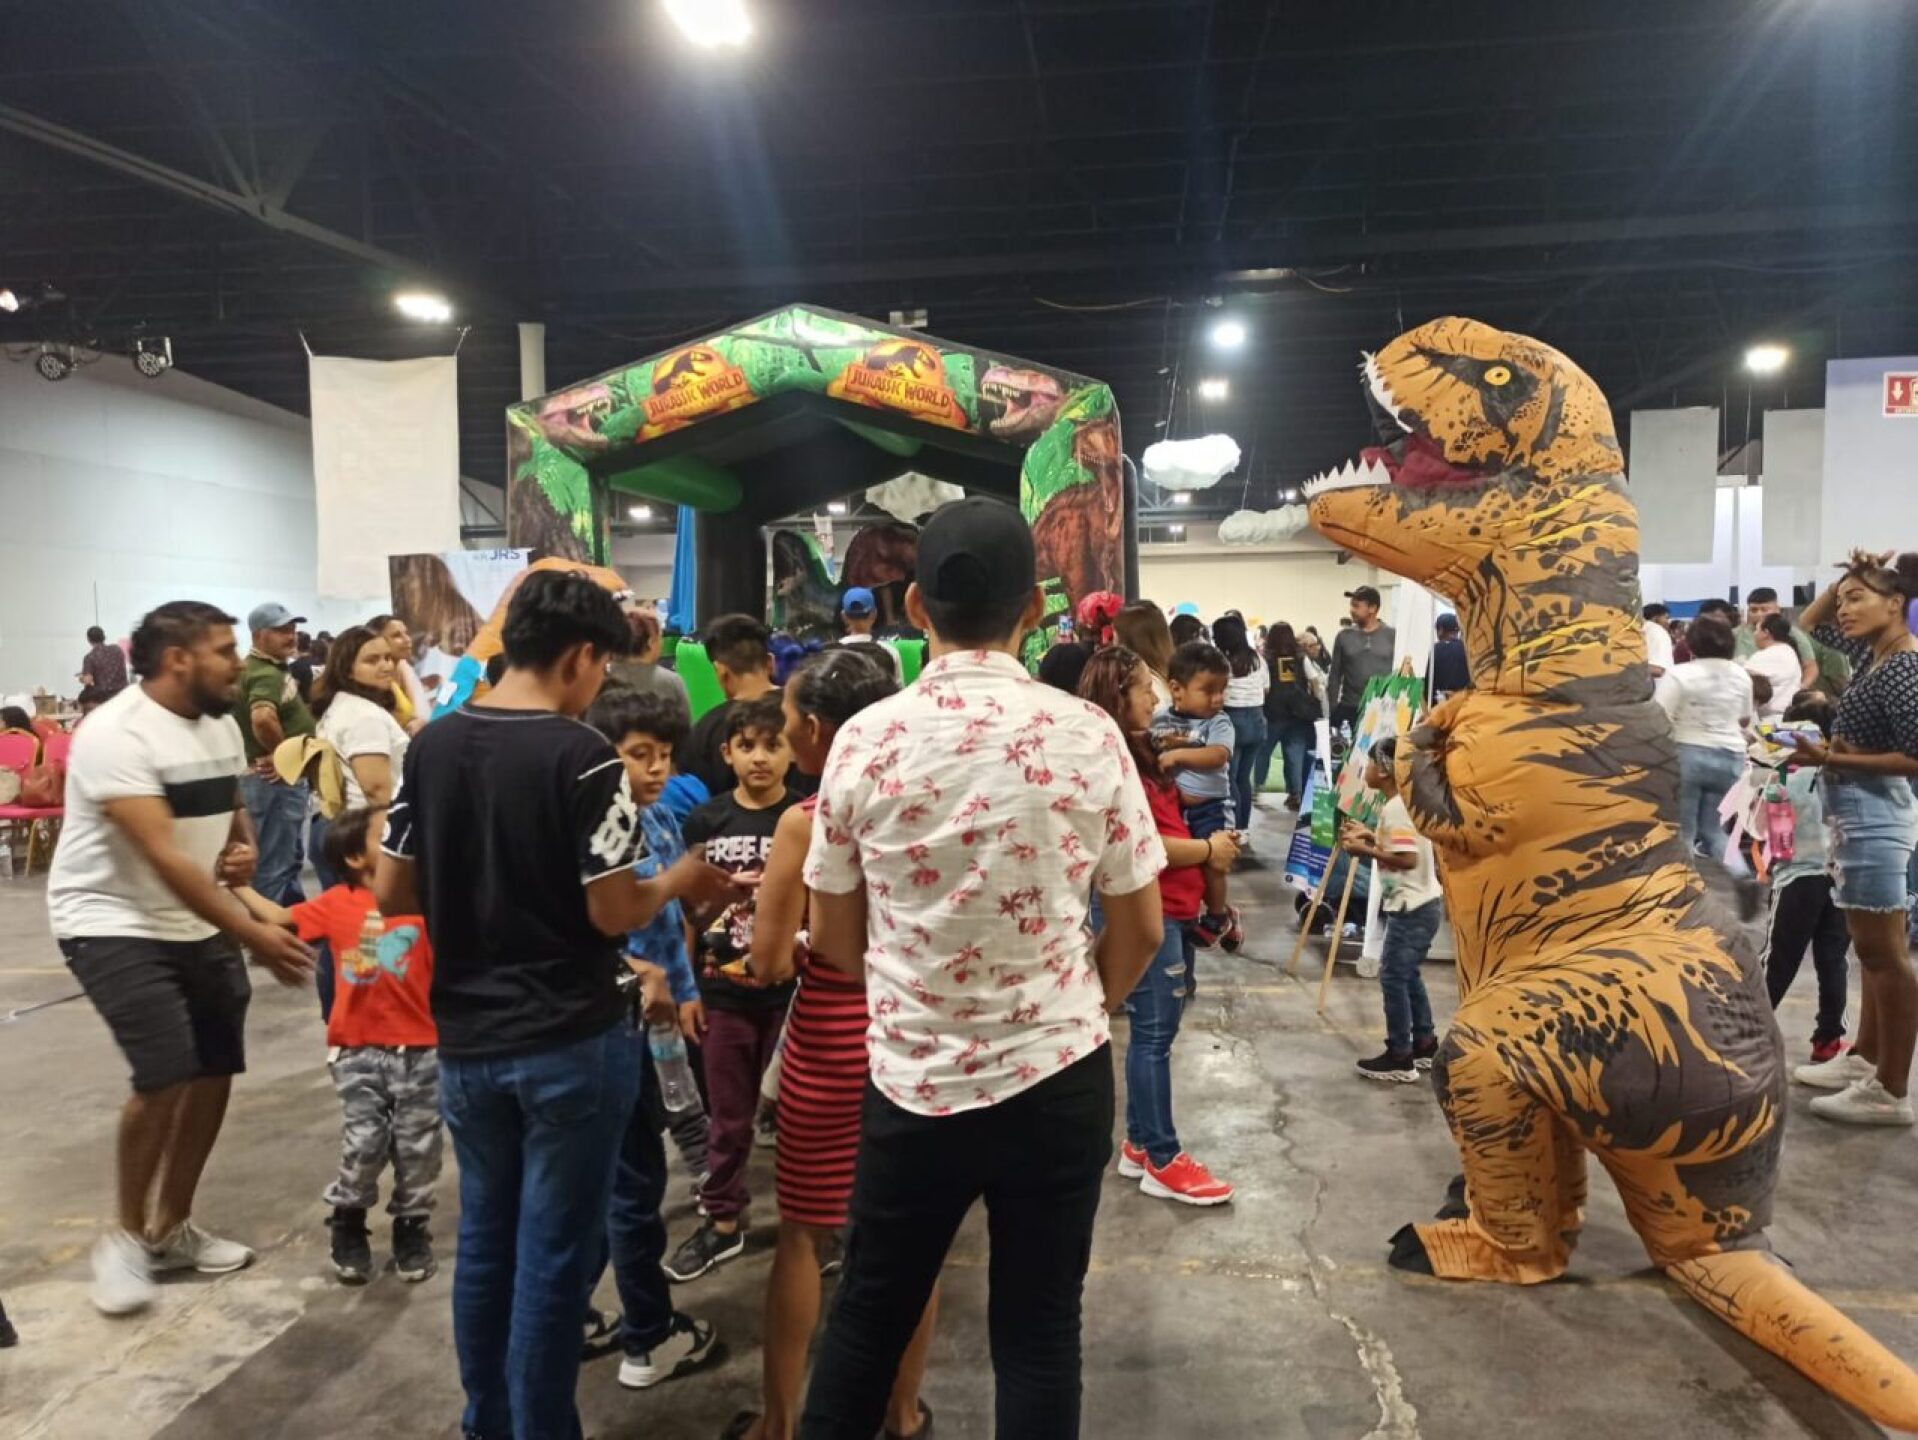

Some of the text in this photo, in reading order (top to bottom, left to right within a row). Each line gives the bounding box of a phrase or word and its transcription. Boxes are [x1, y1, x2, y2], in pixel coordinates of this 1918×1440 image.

[648, 387, 698, 418] JURASSIC
[698, 372, 743, 400] WORLD
[850, 368, 902, 396] JURASSIC
[904, 382, 950, 408] WORLD
[705, 836, 758, 864] FREE
